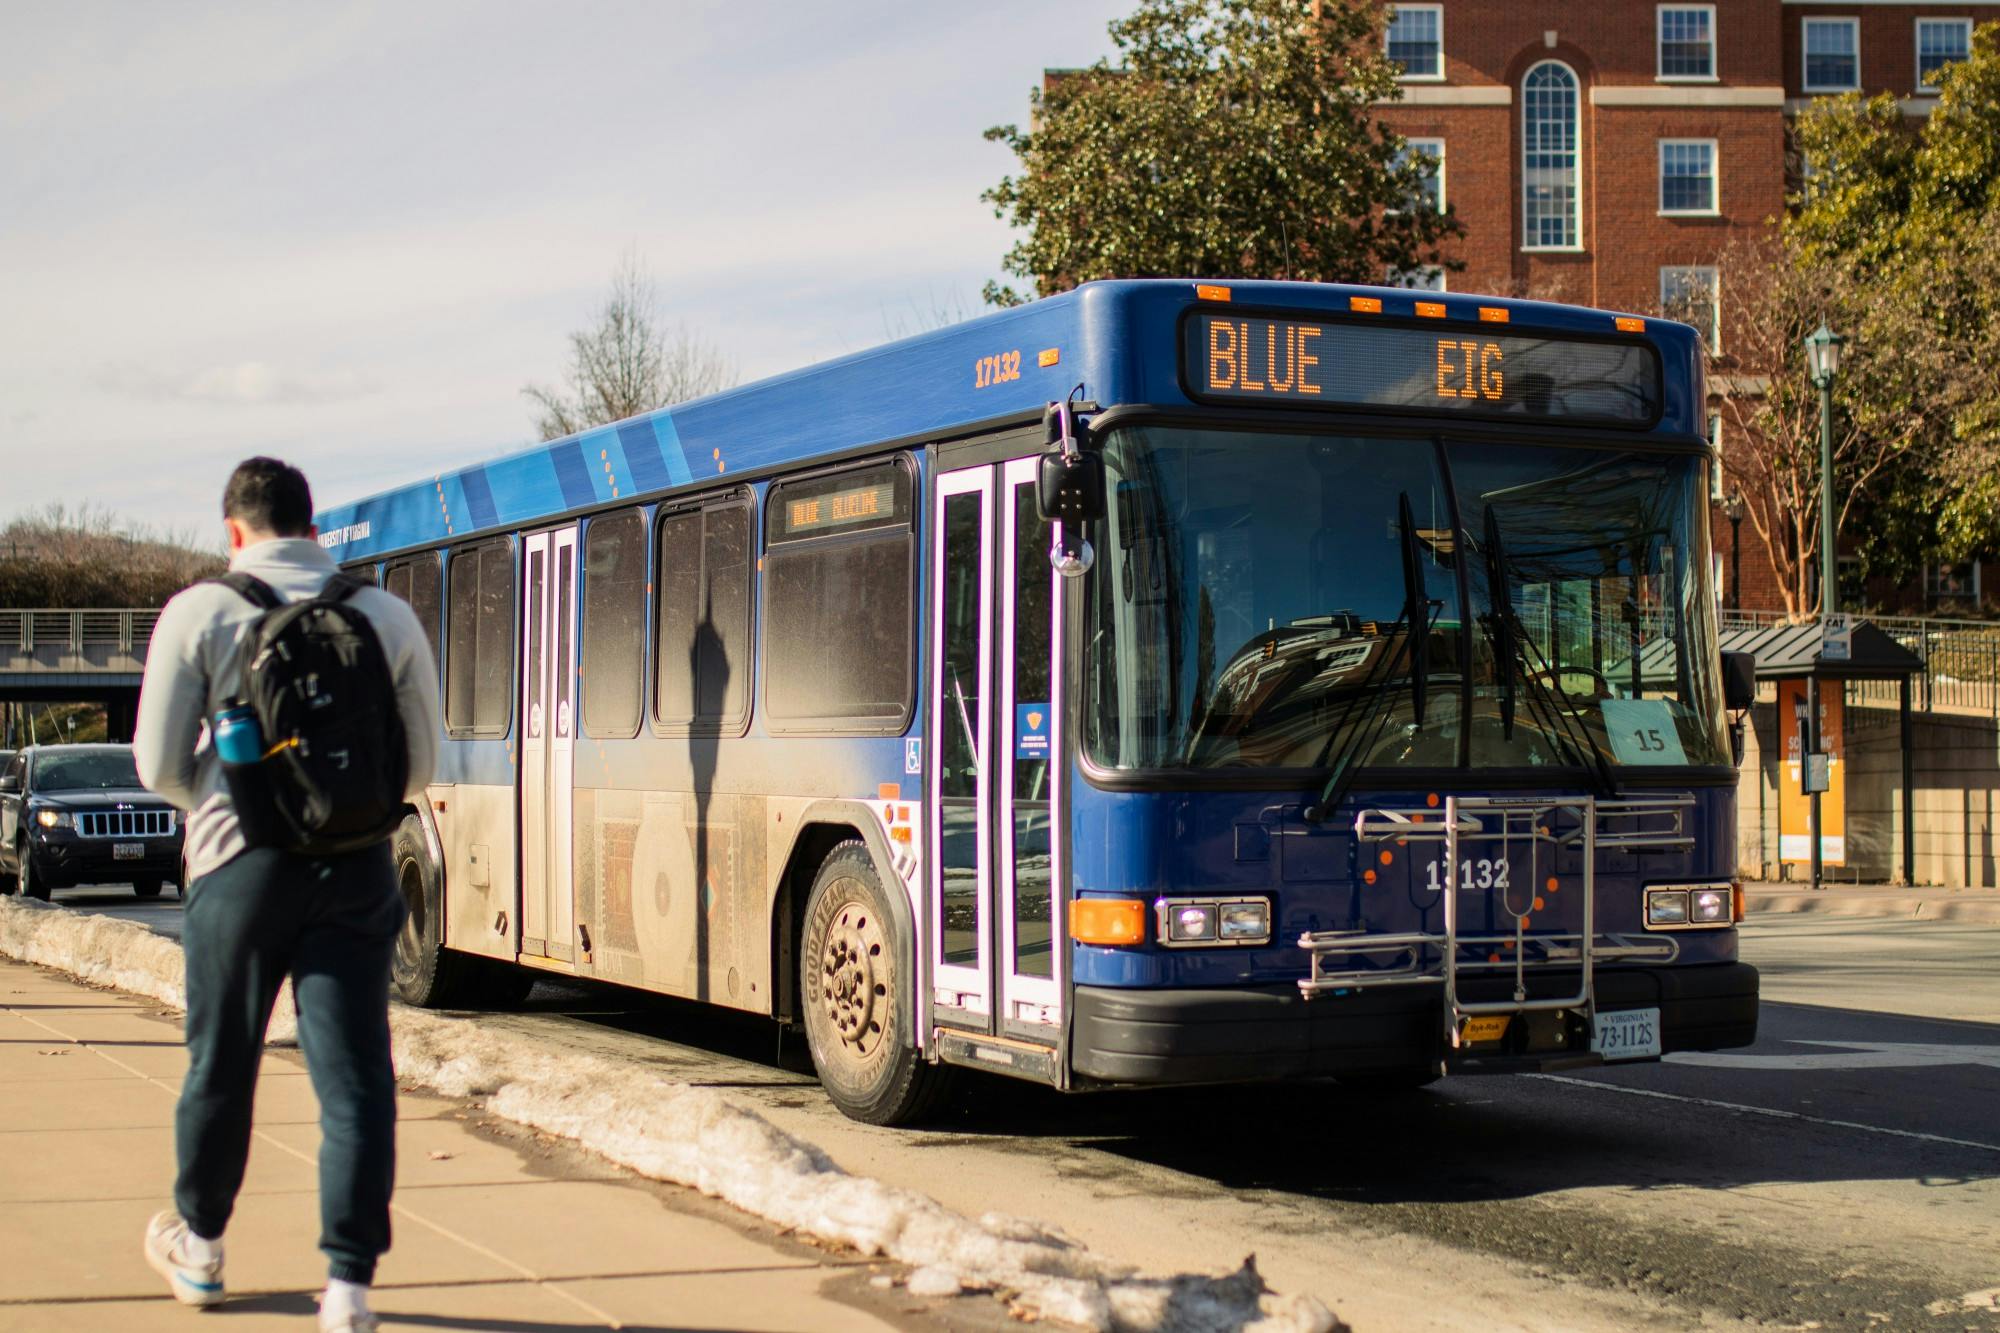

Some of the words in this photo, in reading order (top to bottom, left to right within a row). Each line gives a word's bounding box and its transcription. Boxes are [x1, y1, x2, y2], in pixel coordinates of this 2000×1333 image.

[975, 350, 1021, 388] 17132
[1210, 321, 1321, 393] BLUE
[1437, 340, 1502, 399] EIG
[1634, 728, 1665, 752] 15
[1609, 1013, 1645, 1024] VIRGINIA
[1600, 1022, 1653, 1049] 73-112S
